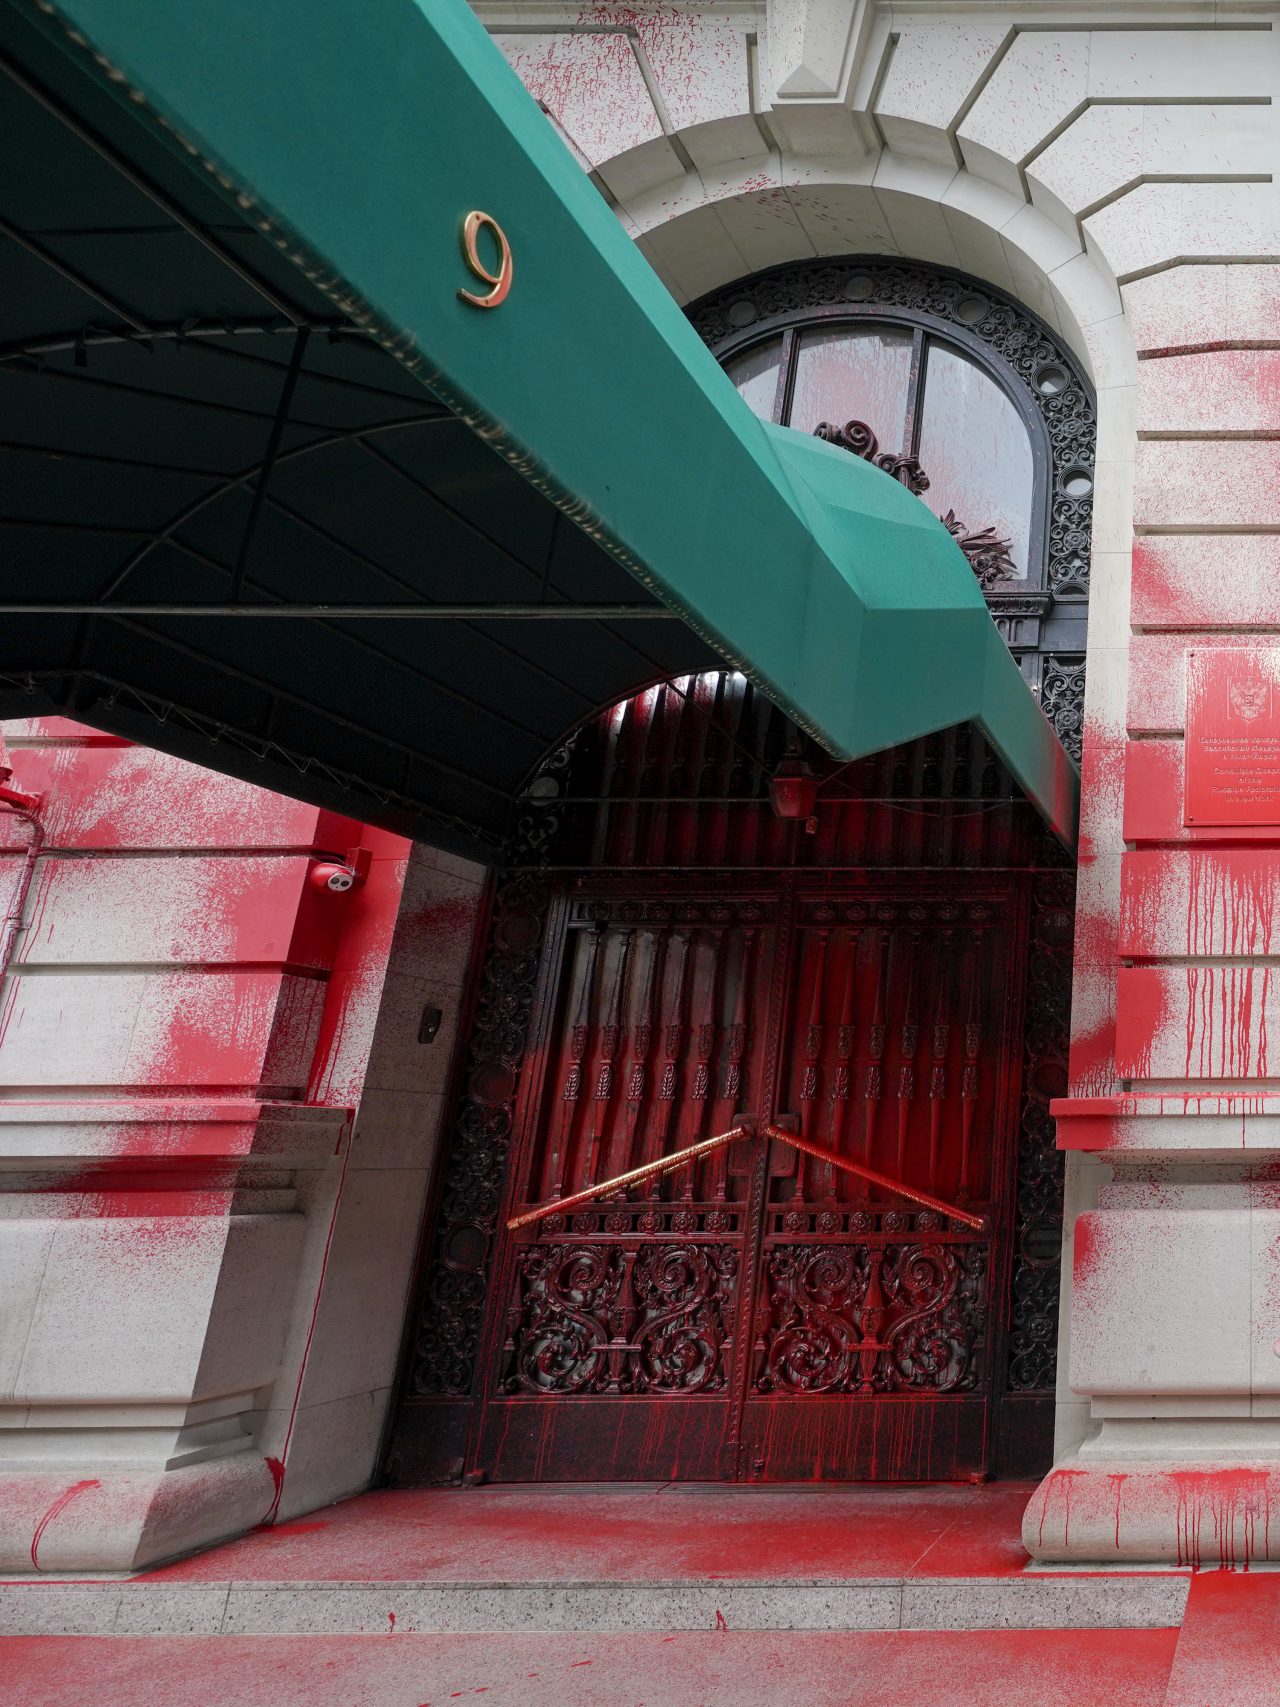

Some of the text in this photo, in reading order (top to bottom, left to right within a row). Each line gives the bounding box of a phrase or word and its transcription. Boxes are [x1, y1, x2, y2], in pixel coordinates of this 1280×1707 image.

[458, 209, 513, 308] 9
[1213, 767, 1254, 775] Consulate
[1212, 785, 1244, 793] Russian
[1255, 794, 1275, 802] York
